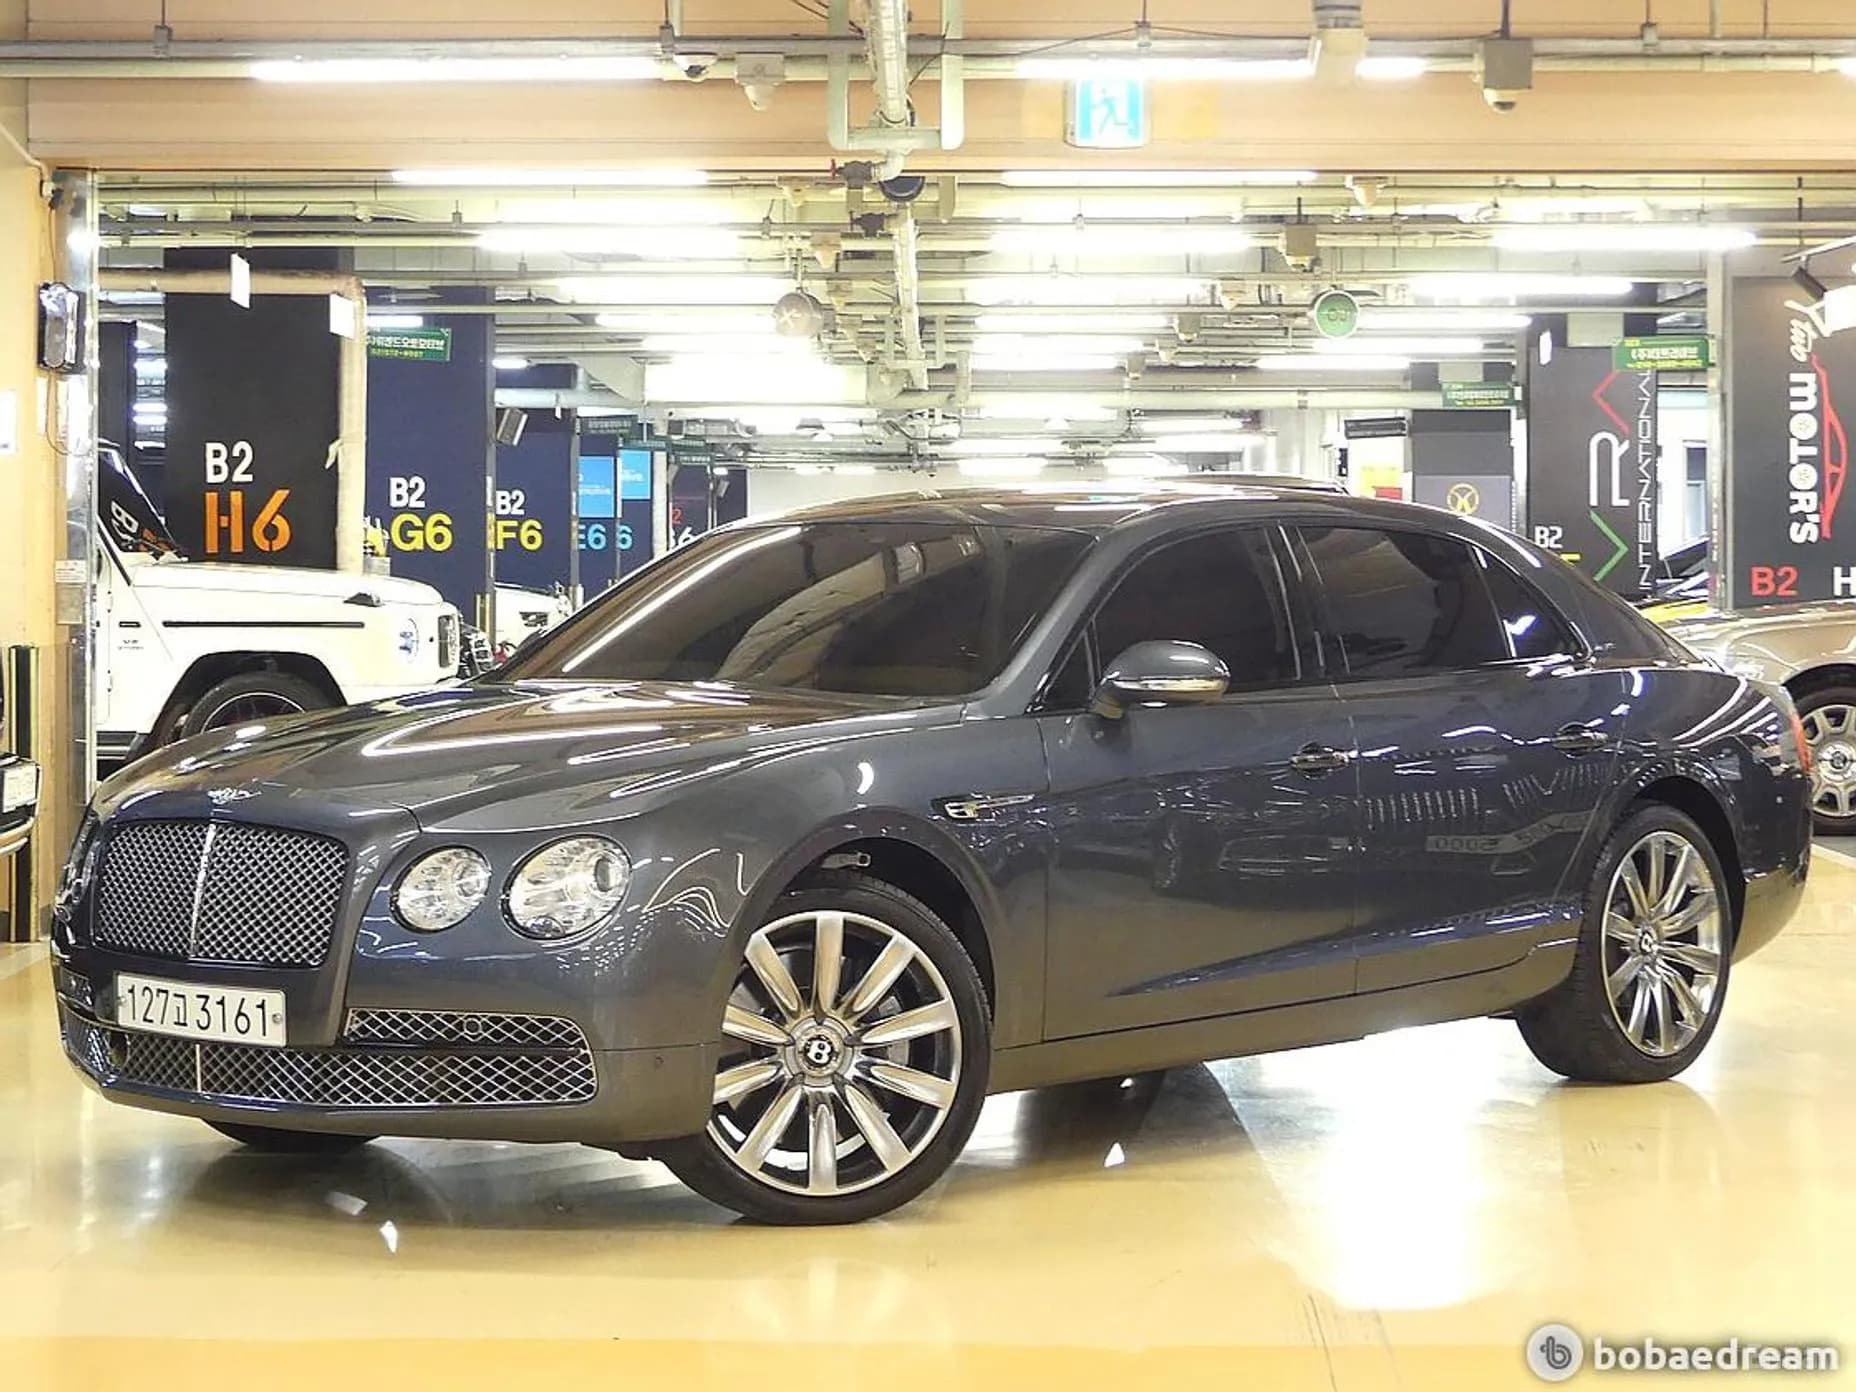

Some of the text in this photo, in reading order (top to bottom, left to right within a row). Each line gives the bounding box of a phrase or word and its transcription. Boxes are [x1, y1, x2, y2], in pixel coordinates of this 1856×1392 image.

[205, 440, 254, 483] B2
[389, 475, 426, 508] B2
[495, 489, 525, 515] B2
[205, 489, 291, 553] H6
[390, 512, 453, 551] G6
[495, 518, 543, 551] F6
[1534, 526, 1563, 549] B2
[1750, 565, 1799, 597] B2
